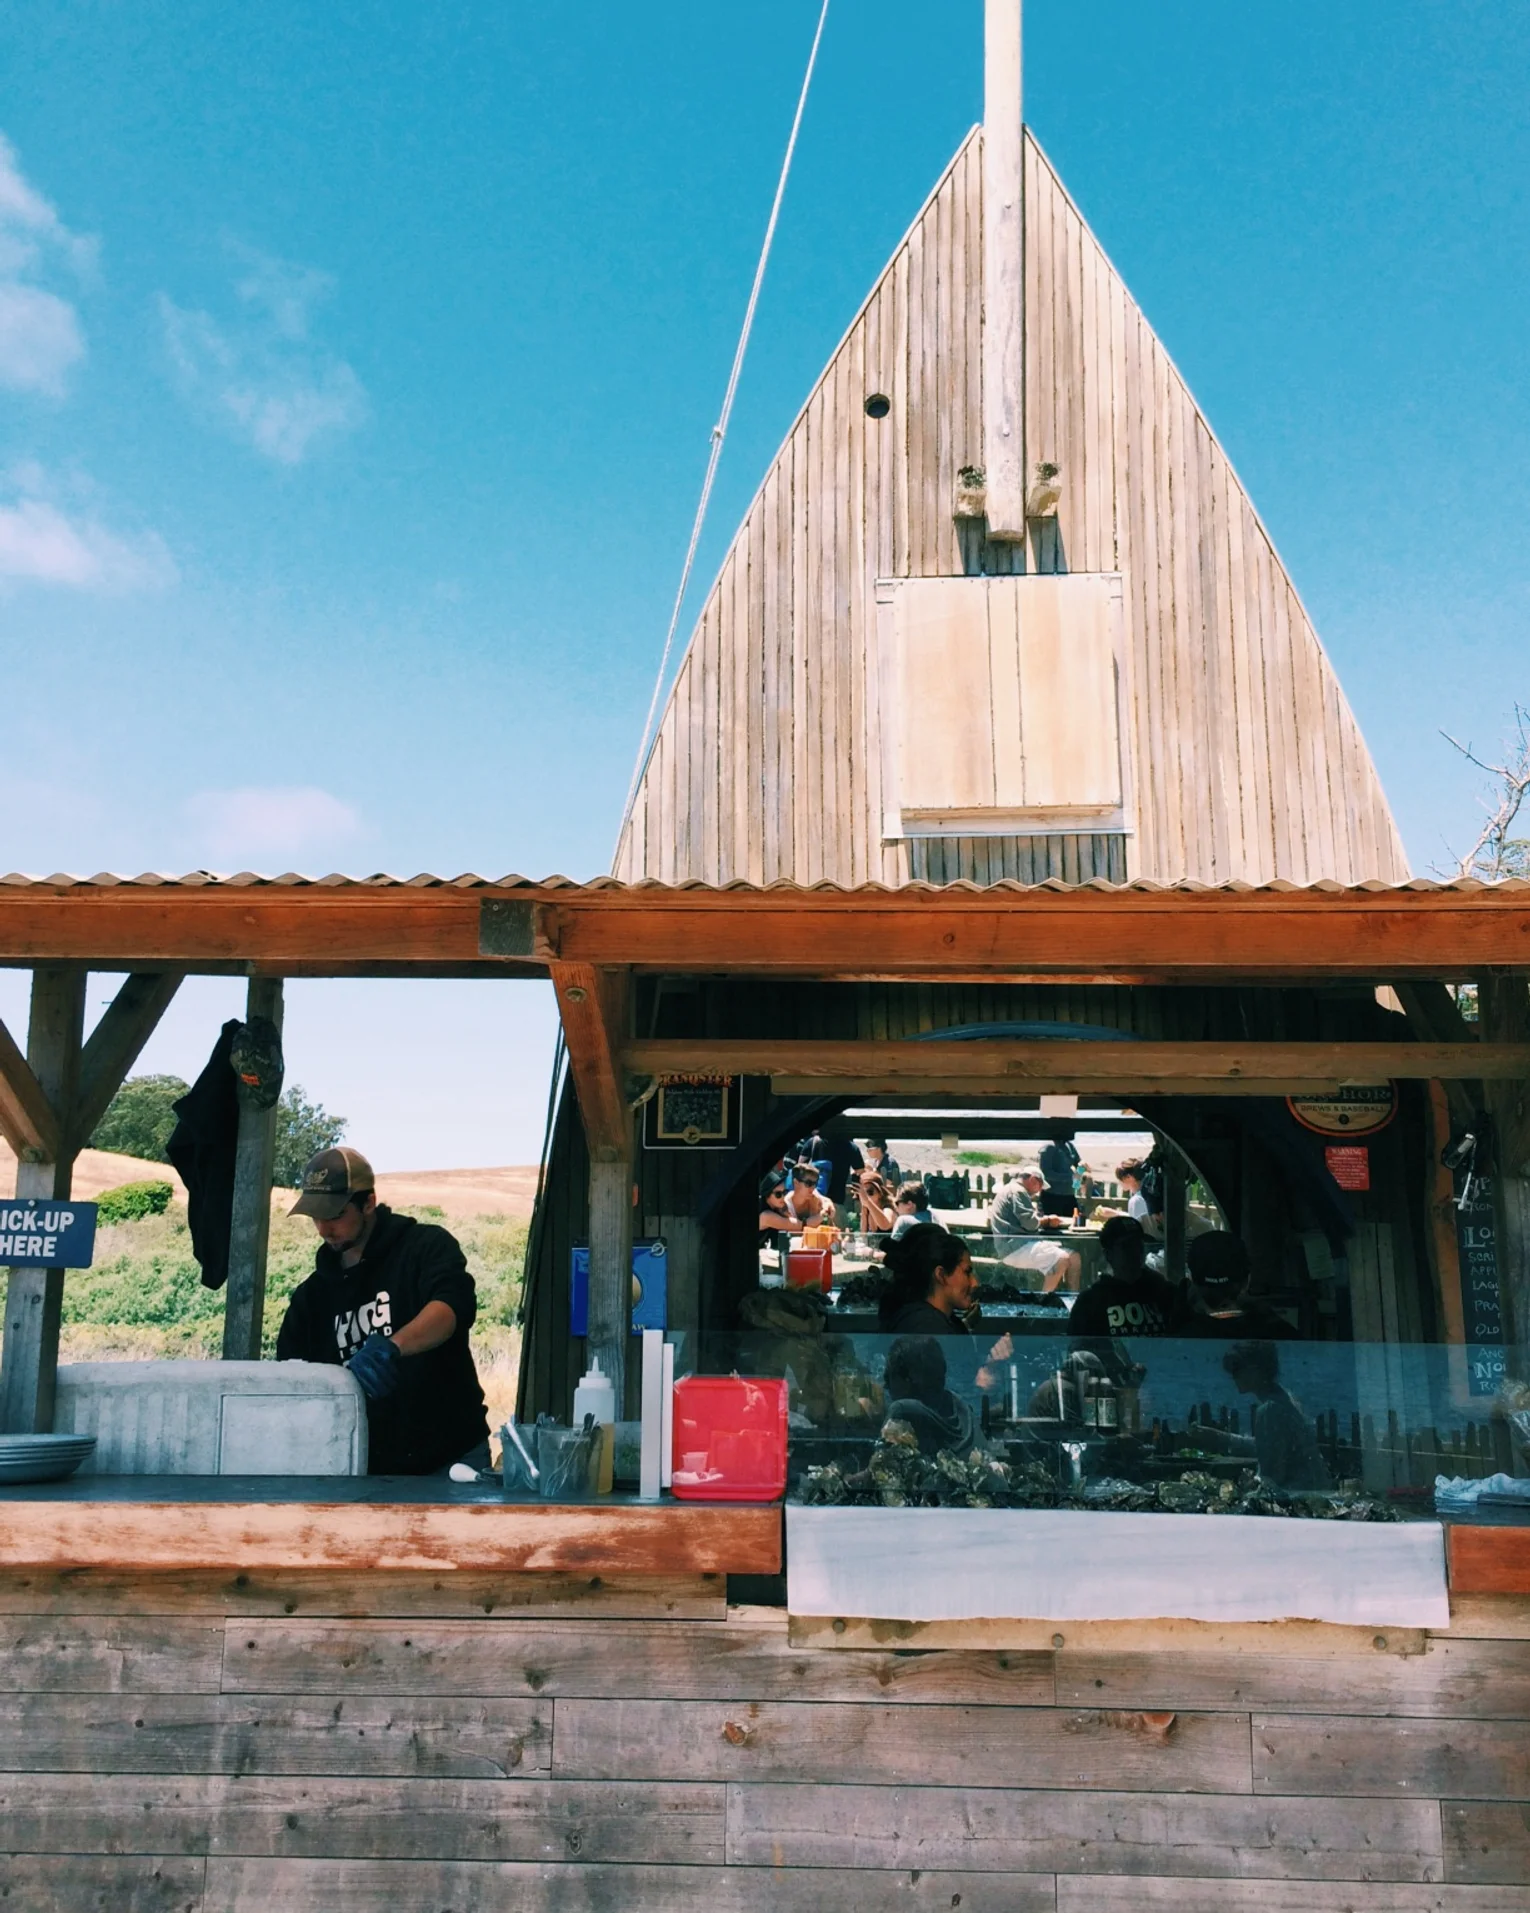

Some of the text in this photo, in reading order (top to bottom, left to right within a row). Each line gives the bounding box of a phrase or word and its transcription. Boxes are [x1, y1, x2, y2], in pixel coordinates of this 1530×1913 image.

[1300, 1104, 1331, 1113] BREWS
[1340, 1104, 1385, 1113] BASEBALL
[0, 1210, 74, 1233] ICK-UP
[0, 1235, 57, 1257] HERE
